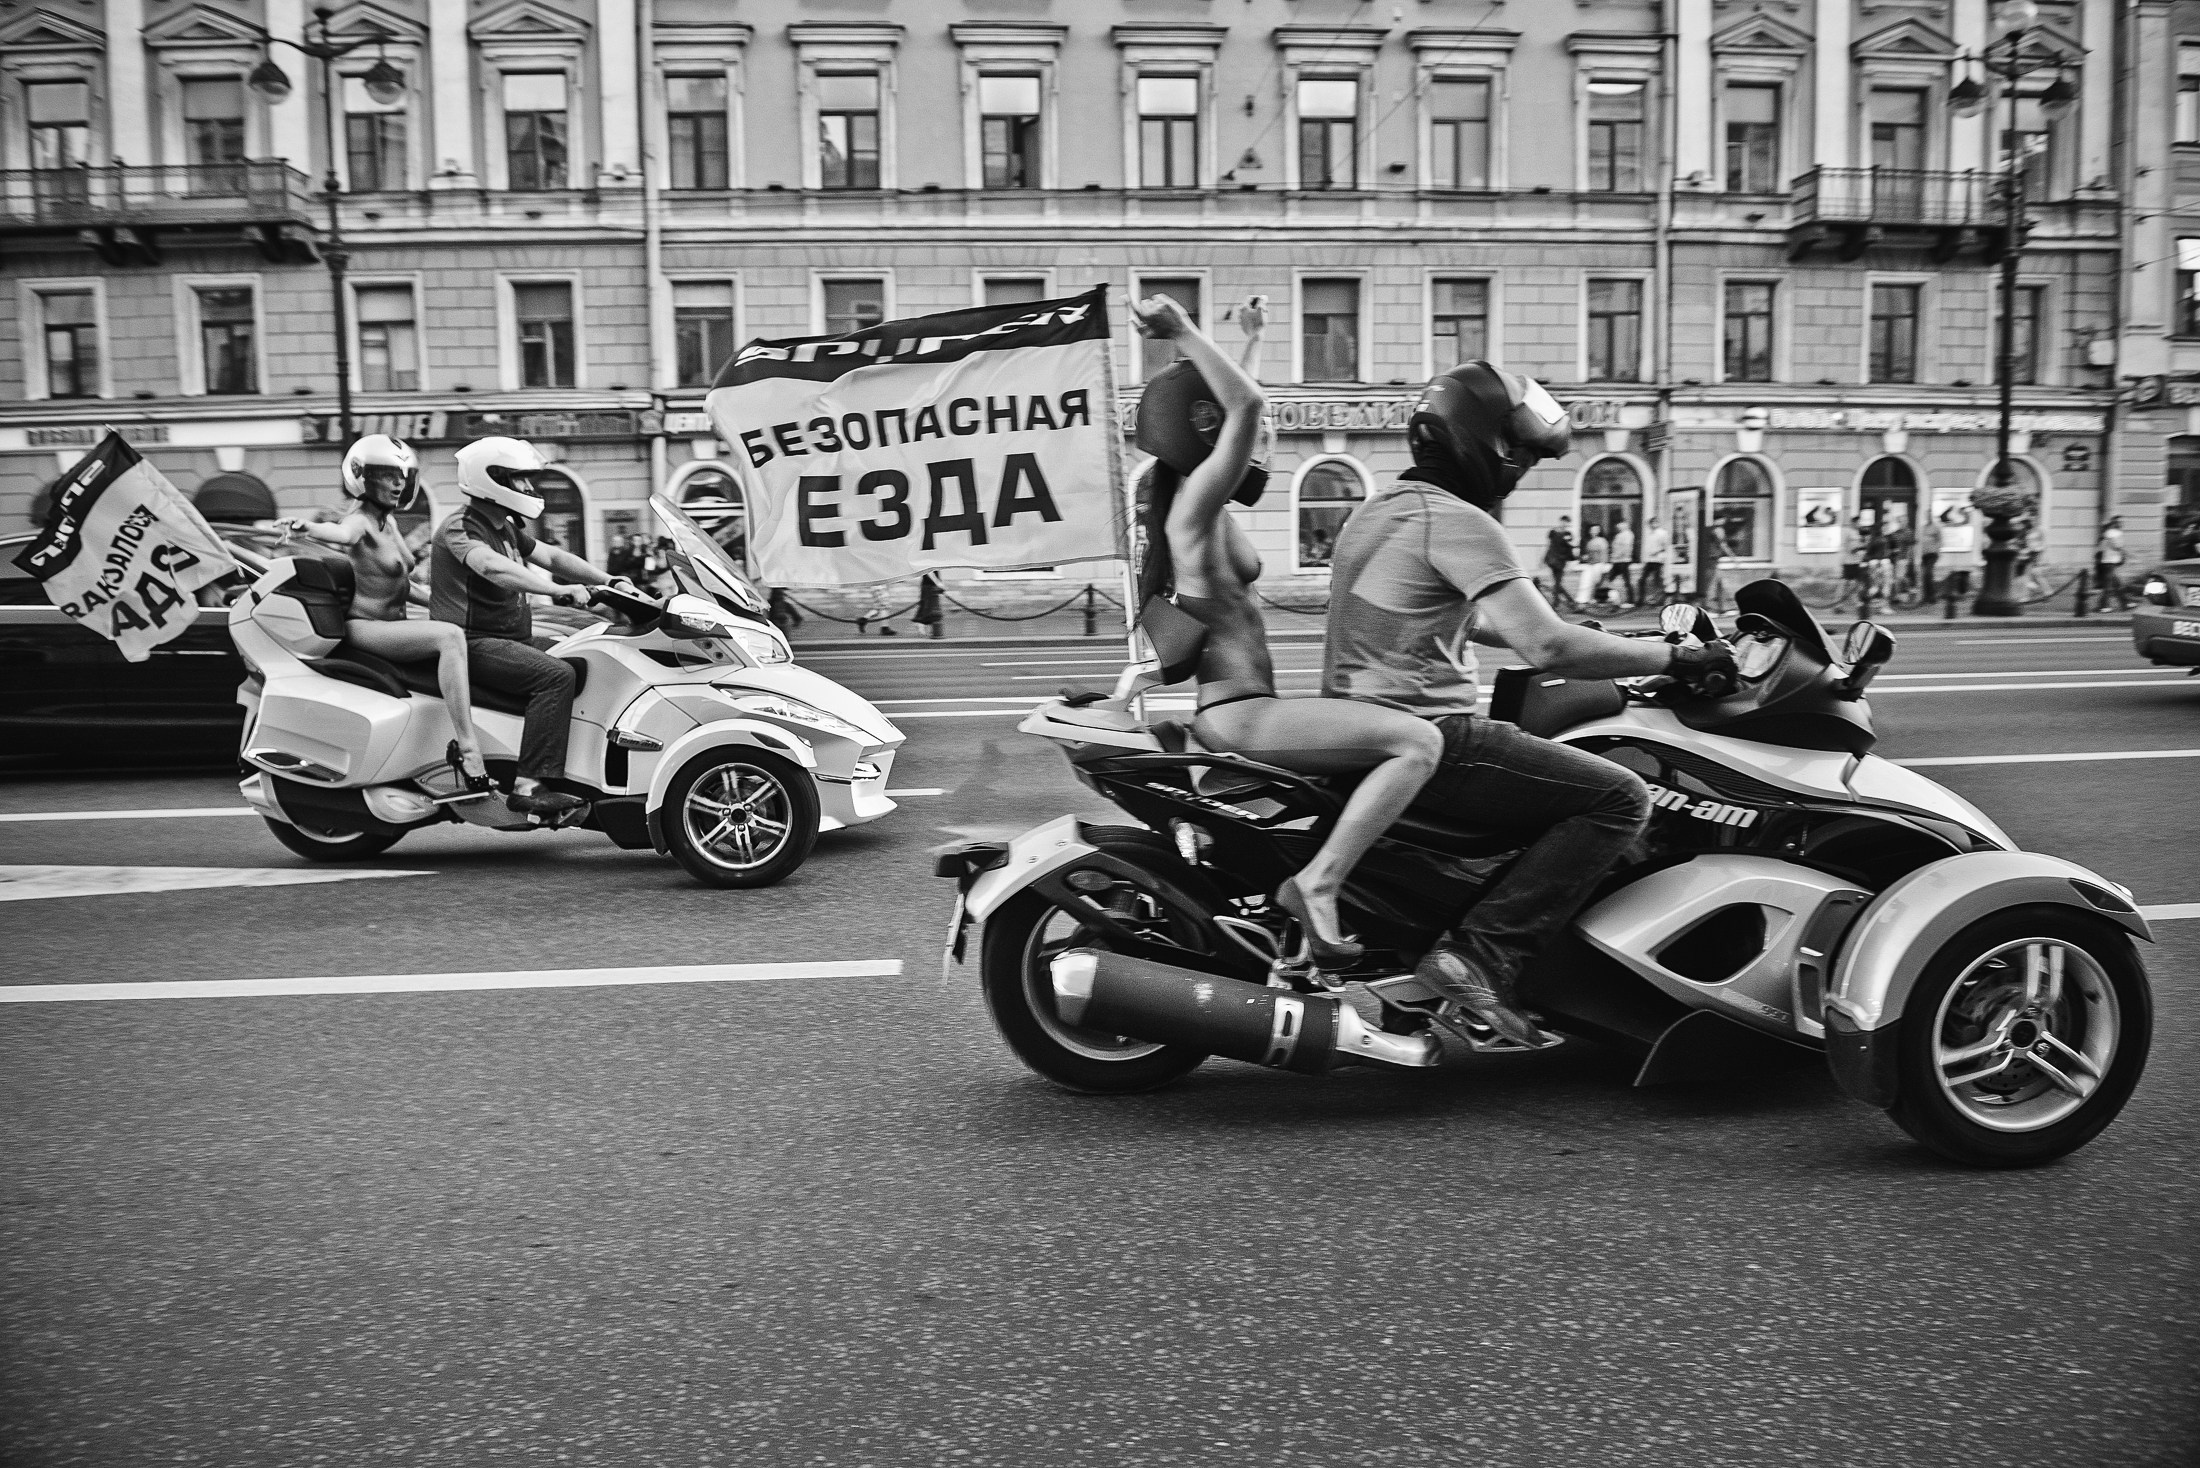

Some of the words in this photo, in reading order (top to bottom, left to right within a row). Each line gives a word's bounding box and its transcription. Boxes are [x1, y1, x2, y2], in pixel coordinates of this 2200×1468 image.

[740, 388, 1090, 468] БЕЗОПАСНАЯ
[798, 452, 1064, 551] ЕЗДА
[1646, 783, 1759, 828] an-am
